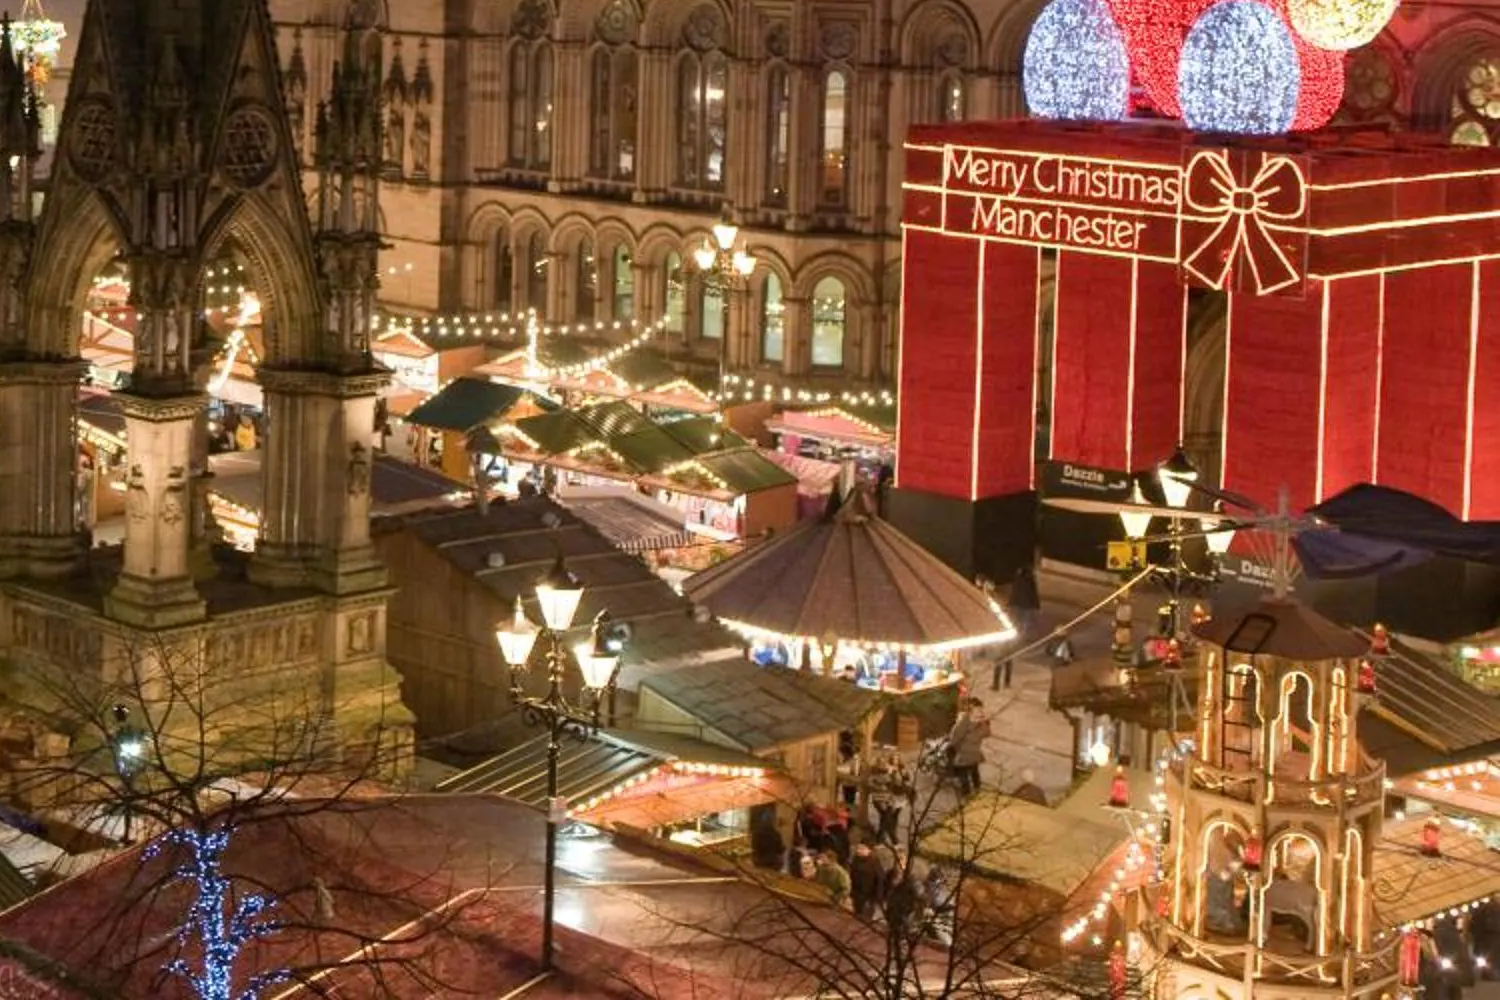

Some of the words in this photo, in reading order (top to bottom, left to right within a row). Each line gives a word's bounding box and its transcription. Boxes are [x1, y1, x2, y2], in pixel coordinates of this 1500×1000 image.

[945, 149, 1027, 200] Merry
[1034, 155, 1180, 206] Christmas
[972, 196, 1147, 250] Manchester
